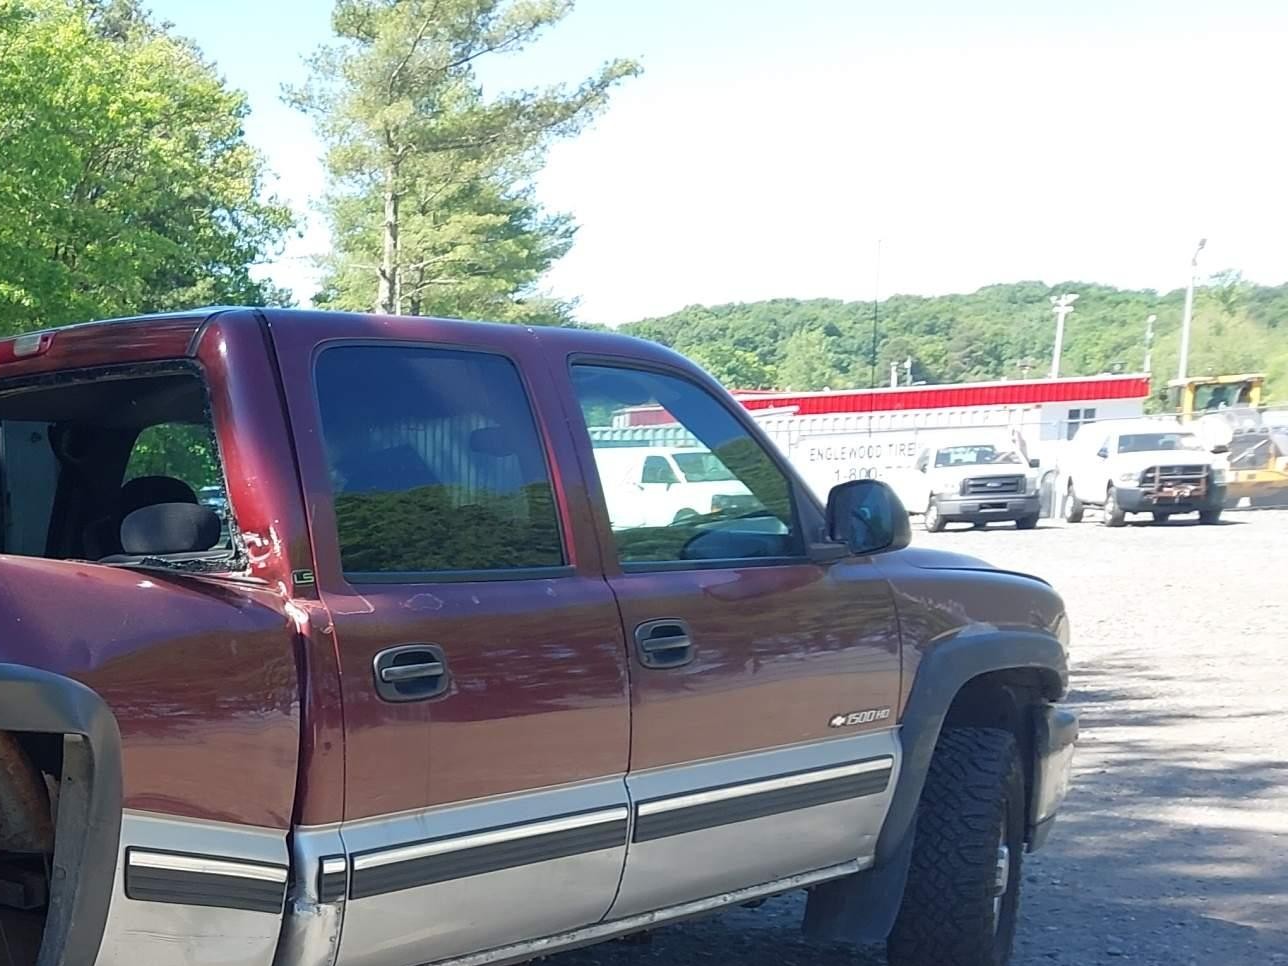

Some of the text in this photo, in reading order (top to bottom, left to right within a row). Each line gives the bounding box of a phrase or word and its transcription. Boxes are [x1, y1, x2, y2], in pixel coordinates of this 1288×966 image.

[809, 441, 917, 462] ENGLEWOOD TIRE
[294, 572, 314, 584] LS
